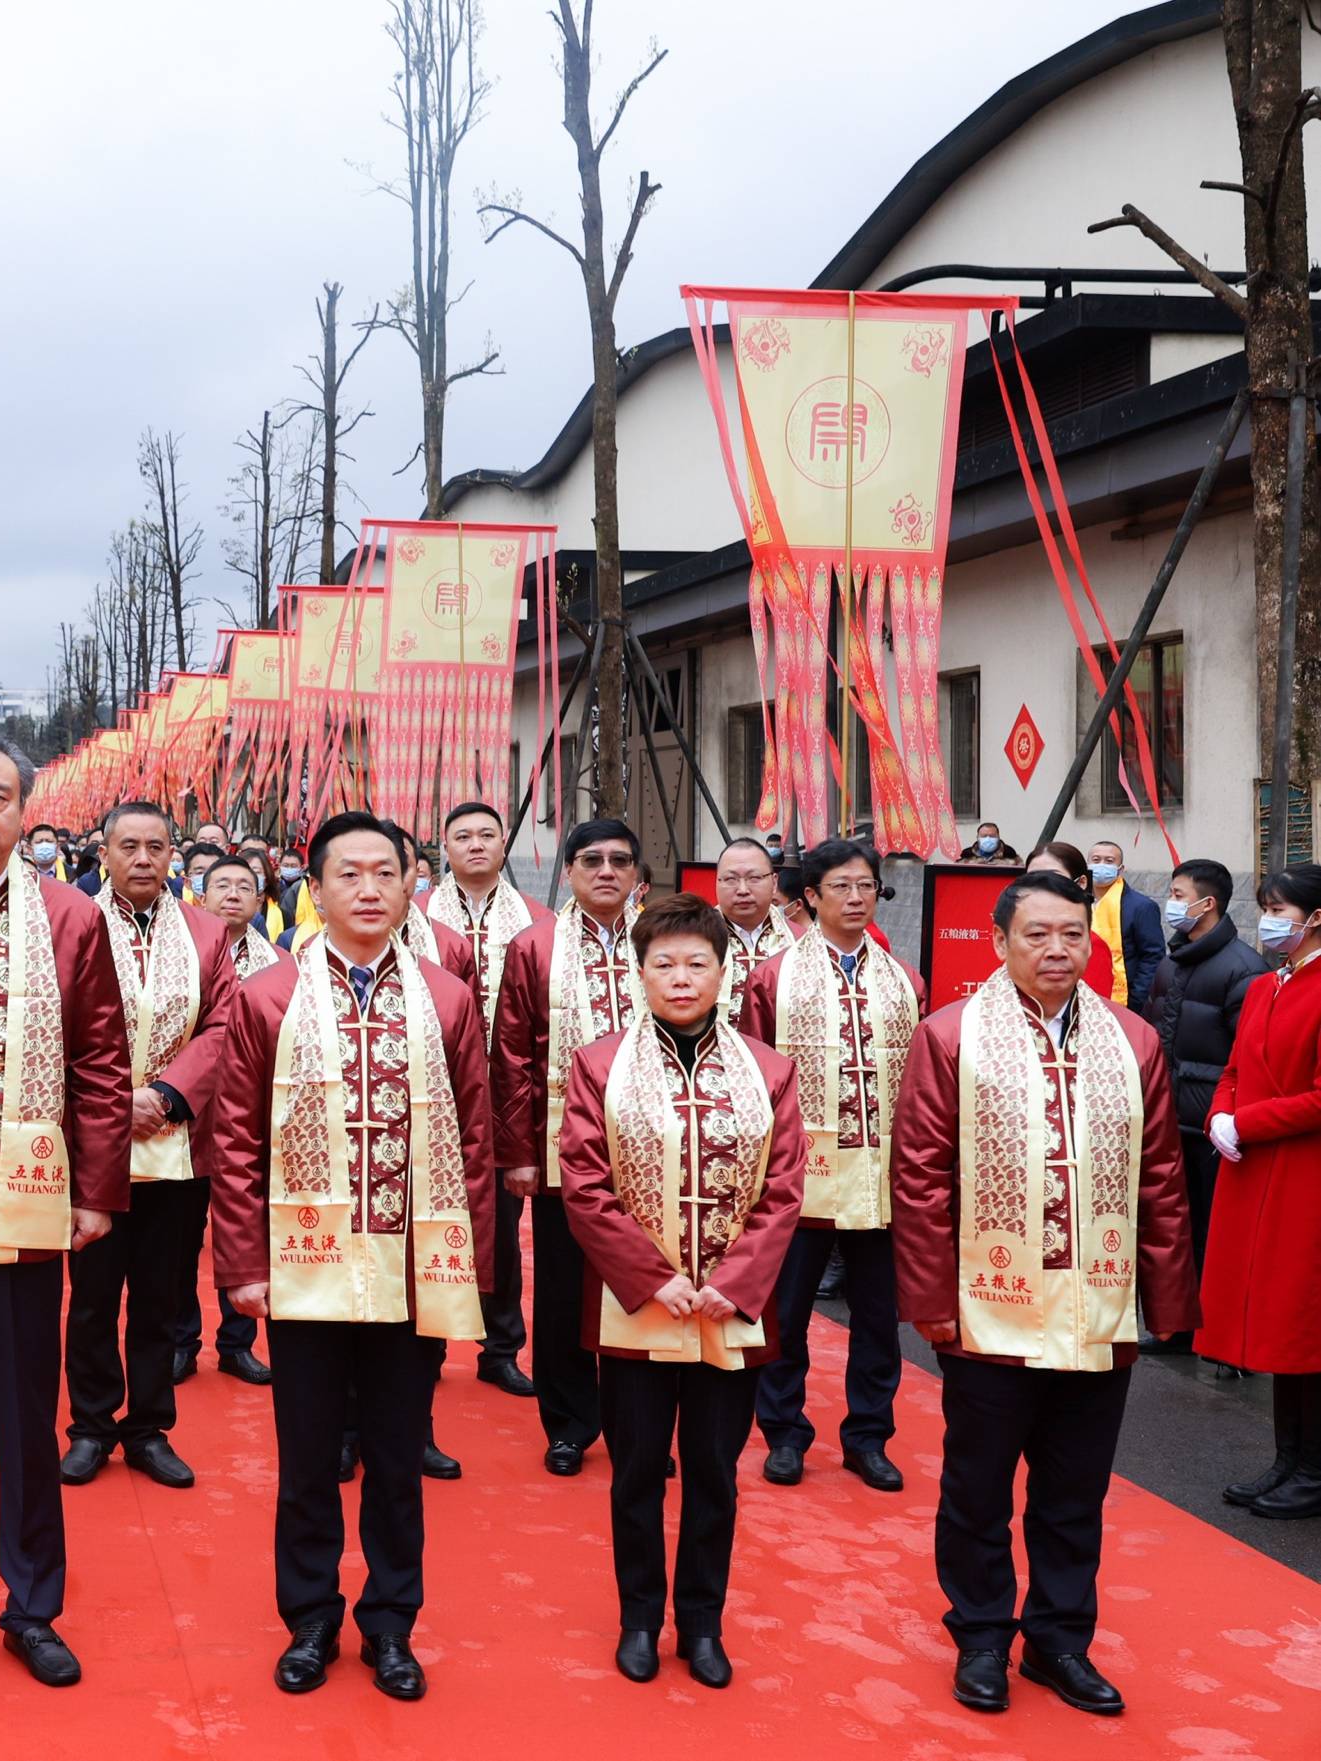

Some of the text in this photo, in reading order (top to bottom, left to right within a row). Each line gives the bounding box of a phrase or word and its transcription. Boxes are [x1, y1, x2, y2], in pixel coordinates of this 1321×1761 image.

[938, 927, 993, 940] 五粮液第二
[8, 1164, 65, 1182] 五粮液
[7, 1181, 65, 1194] WULIANGYE
[280, 1234, 342, 1252] 五粮液
[280, 1254, 343, 1264] WULIANGYE
[1087, 1259, 1132, 1275] 五粮液
[969, 1272, 1032, 1294] 五粮液
[968, 1290, 1035, 1306] WULIANGYE
